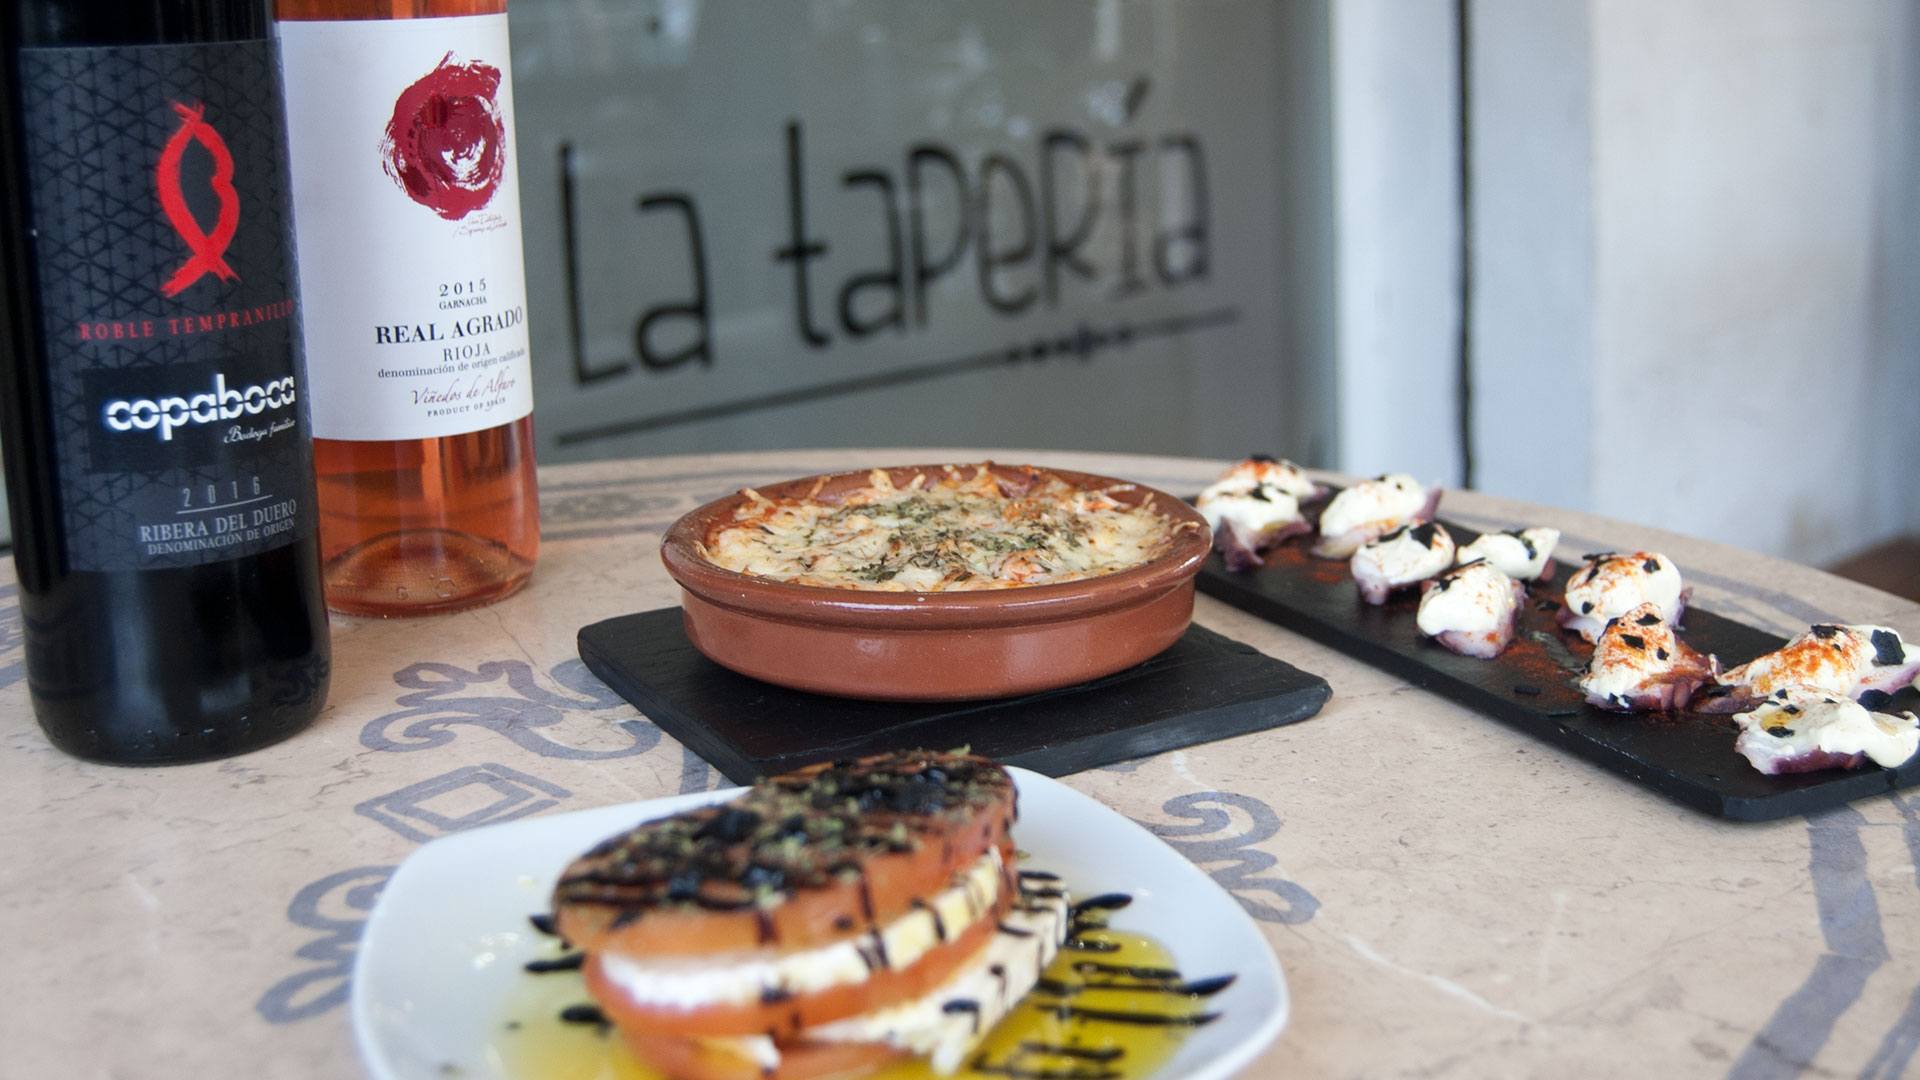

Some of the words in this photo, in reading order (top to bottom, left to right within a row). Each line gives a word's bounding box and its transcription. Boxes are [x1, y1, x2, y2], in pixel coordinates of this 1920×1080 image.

[556, 142, 714, 387] La
[439, 278, 486, 297] 2015
[439, 296, 487, 310] GARNACHA
[78, 320, 155, 341] ROBLE
[168, 299, 294, 336] TEMPRANILLO
[375, 323, 444, 345] REAL
[451, 306, 523, 339] AGRADO
[377, 364, 455, 378] denominación
[457, 361, 470, 372] de
[471, 357, 498, 370] origen
[443, 342, 491, 362] RIOJA
[411, 377, 462, 405] Viñedos
[466, 374, 482, 399] de
[107, 373, 296, 441] copaboca
[427, 405, 470, 417] PRODUCT
[473, 401, 484, 411] OF
[182, 476, 260, 507] 2016
[140, 520, 209, 542] RIBERA
[215, 512, 248, 534] DEL
[253, 498, 297, 526] DUERO
[246, 528, 261, 541] DE
[263, 517, 296, 537] ORIGEN
